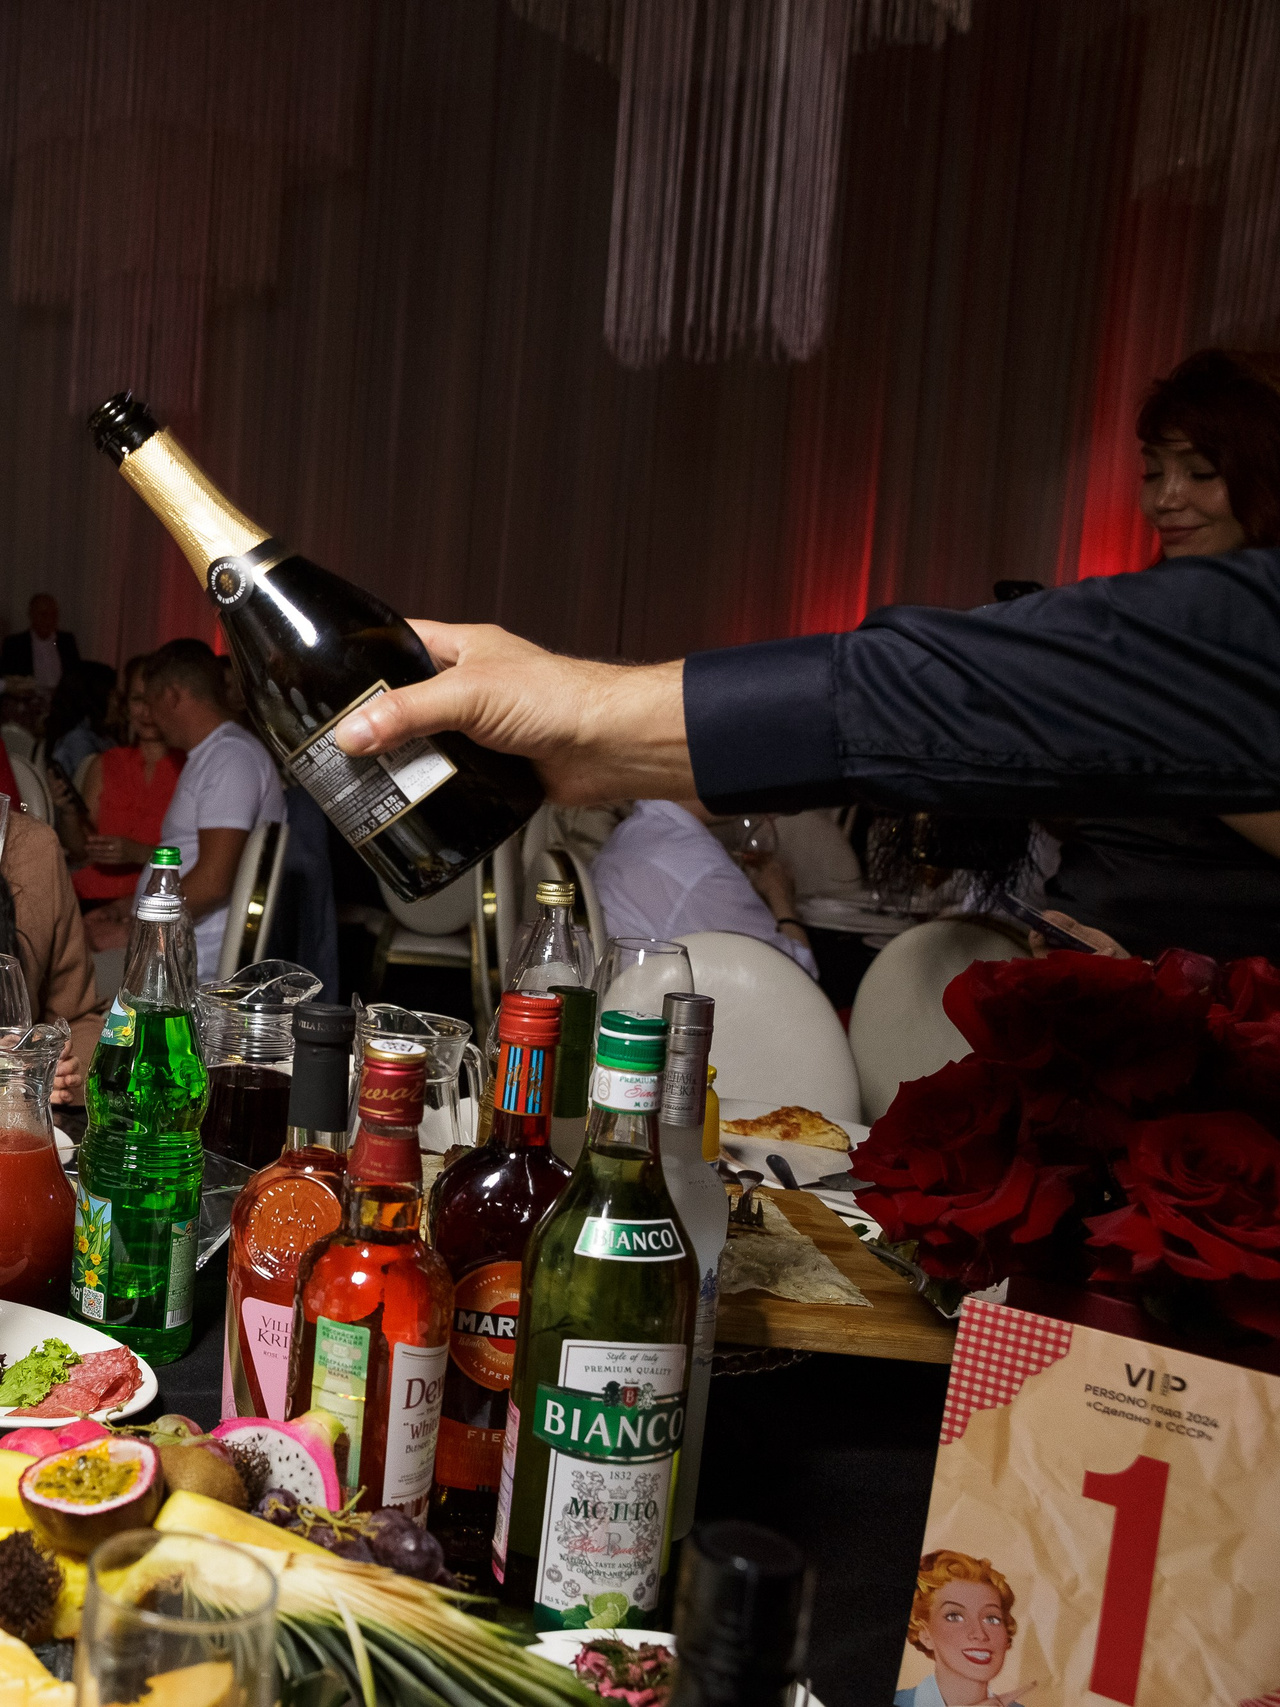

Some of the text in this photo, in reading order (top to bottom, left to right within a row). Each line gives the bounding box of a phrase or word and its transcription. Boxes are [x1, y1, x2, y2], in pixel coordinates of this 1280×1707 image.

[592, 1227, 674, 1251] BIANCO
[457, 1311, 519, 1338] MAR
[584, 1365, 672, 1376] PREMIUM QUALITY
[606, 1352, 660, 1364] Style of Italy
[1124, 1362, 1187, 1397] VIP
[1083, 1383, 1148, 1409] PERSONO
[1150, 1403, 1183, 1420] года
[1185, 1410, 1220, 1429] 2024
[1086, 1401, 1152, 1426] «Сделано
[543, 1399, 685, 1450] BIANCO
[609, 1470, 632, 1481] 1832
[567, 1496, 658, 1522] MOJITO
[594, 1561, 617, 1569] TASTE
[1082, 1454, 1170, 1706] 1
